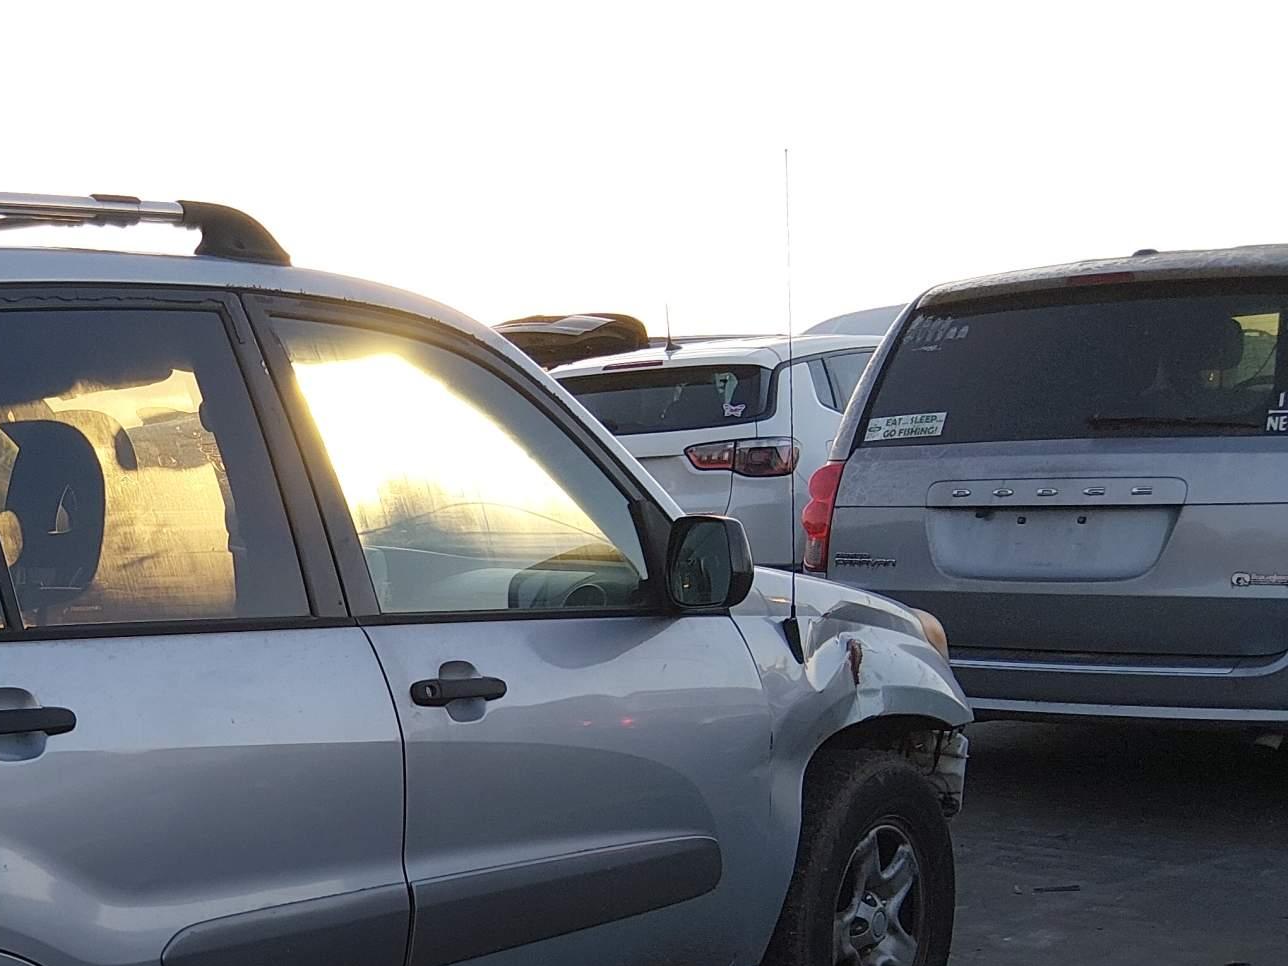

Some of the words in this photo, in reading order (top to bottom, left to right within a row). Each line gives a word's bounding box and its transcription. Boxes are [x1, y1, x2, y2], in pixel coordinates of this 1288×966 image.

[883, 429, 898, 438] GO
[898, 426, 938, 437] FISHING!
[952, 486, 1153, 497] DODGE
